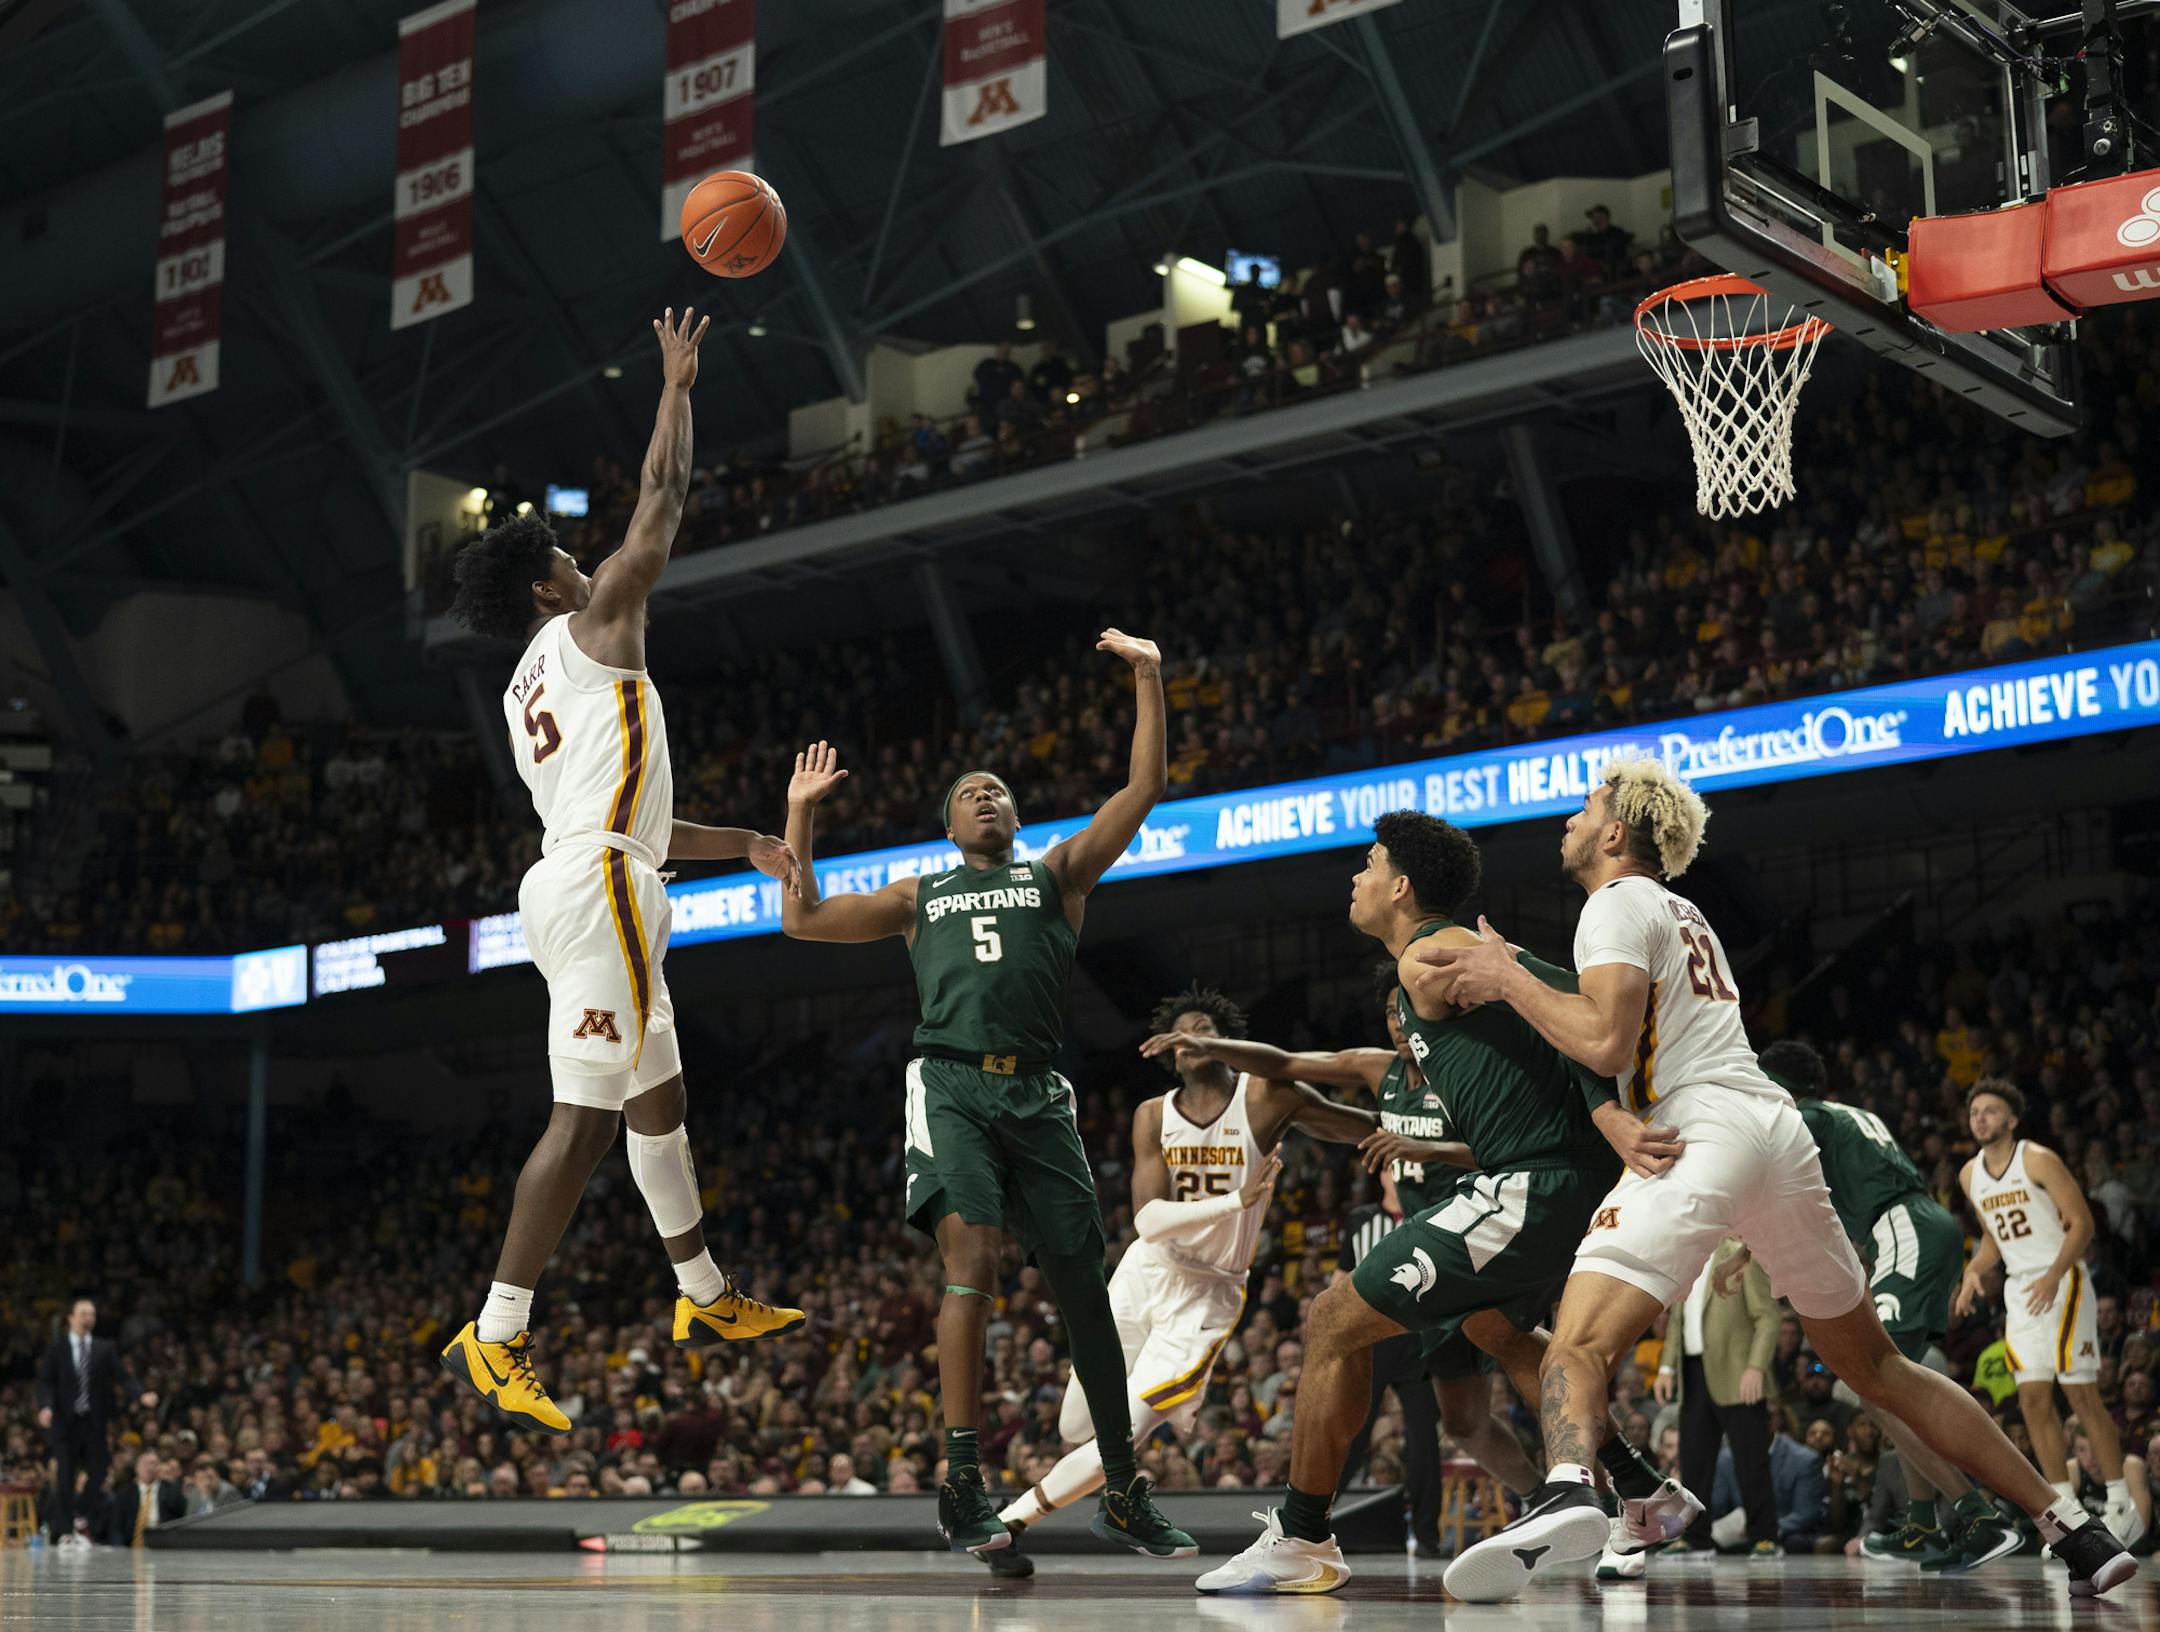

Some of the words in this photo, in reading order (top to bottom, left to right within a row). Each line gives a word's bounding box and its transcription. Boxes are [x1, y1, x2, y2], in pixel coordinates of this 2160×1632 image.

[680, 59, 736, 104] 1907
[966, 79, 1020, 126] M
[512, 654, 546, 704] CARR
[523, 682, 562, 764] 5
[1943, 667, 2101, 739] ACHIEVE
[1659, 706, 1901, 782] PreferredOne
[1216, 791, 1334, 850] ACHIEVE
[1425, 765, 1502, 815] BEST
[925, 887, 1041, 923] SPARTANS
[971, 915, 1003, 963] 5
[1680, 926, 1737, 1001] 21
[573, 1008, 622, 1044] M
[1163, 1146, 1245, 1167] MINNESOTA
[1176, 1171, 1231, 1201] 25
[1982, 1189, 2030, 1213] MINNESOTA
[1995, 1209, 2032, 1241] 22
